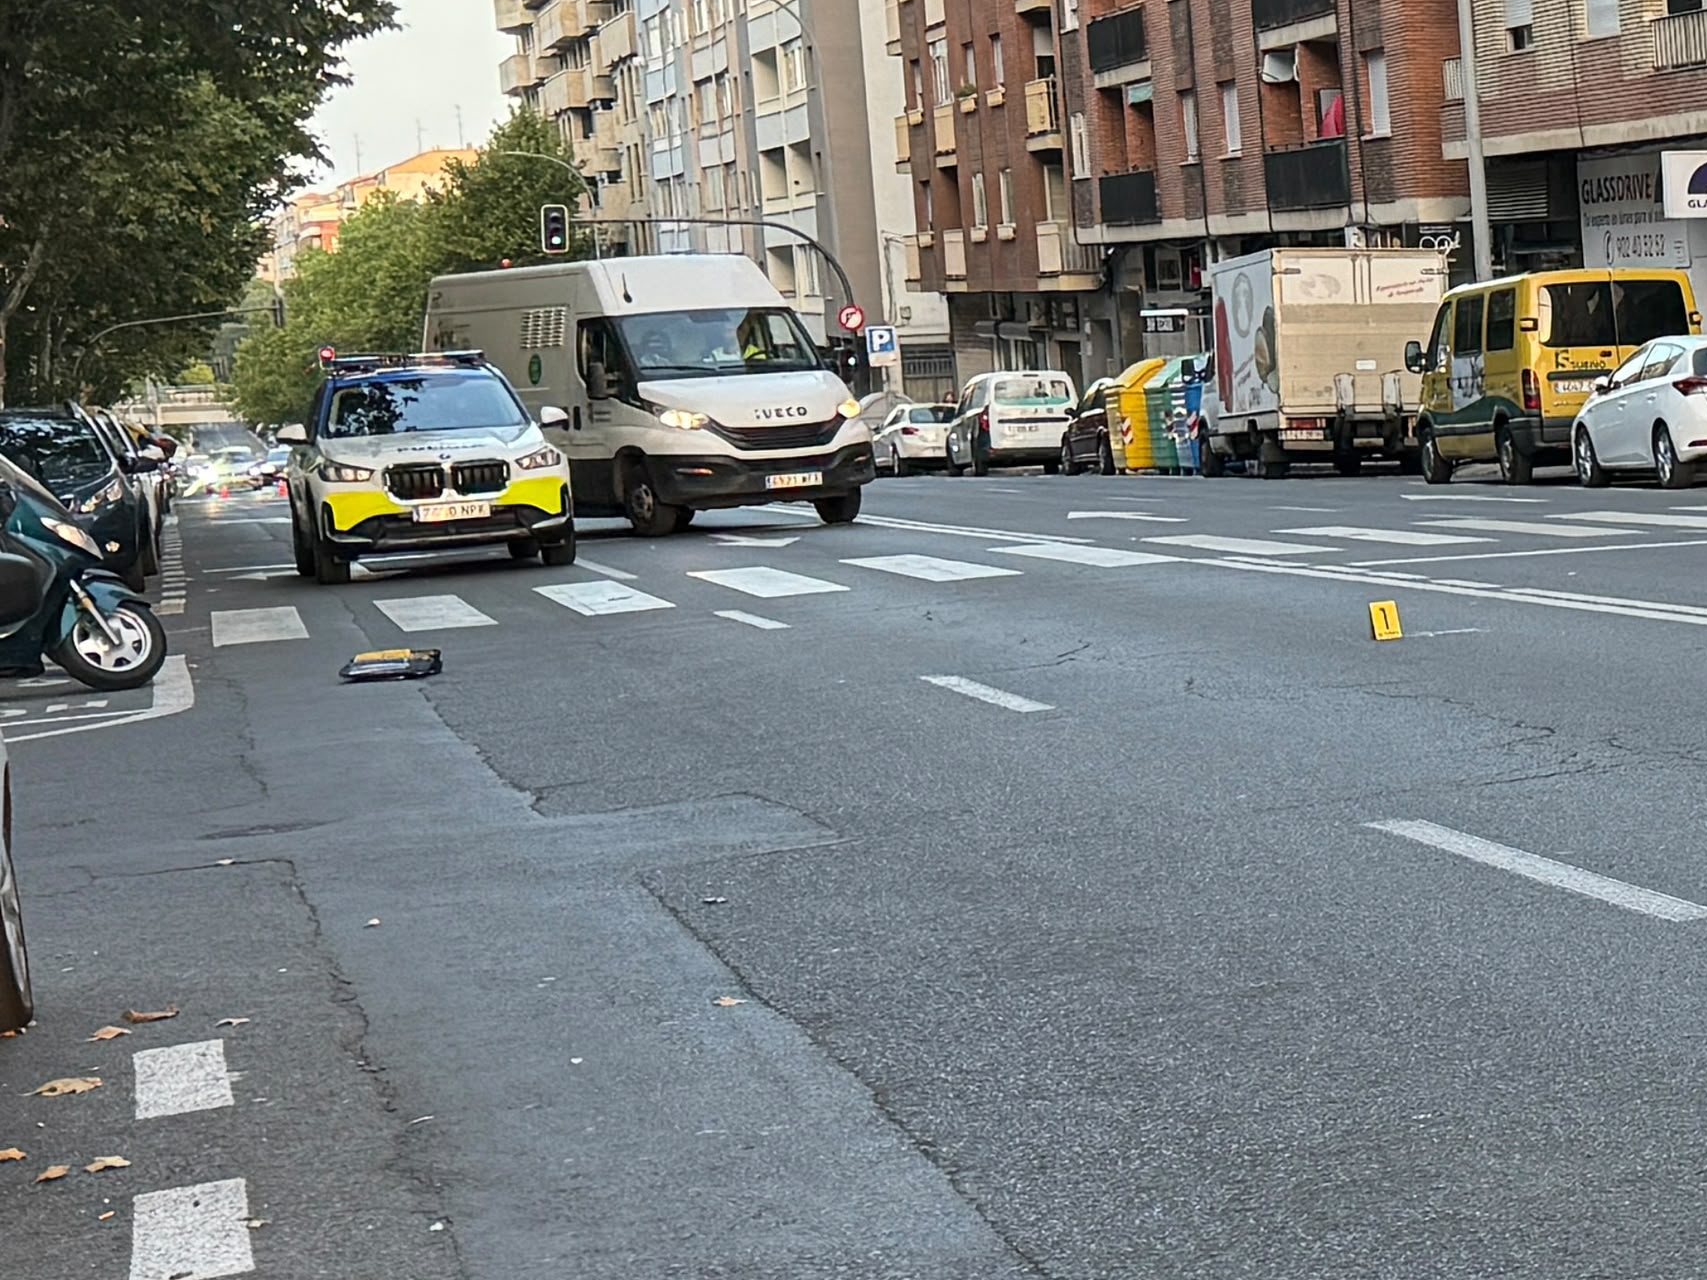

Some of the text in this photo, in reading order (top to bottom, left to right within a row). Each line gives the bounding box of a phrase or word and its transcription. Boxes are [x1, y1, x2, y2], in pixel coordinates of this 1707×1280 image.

[1582, 173, 1652, 204] GLASSDRIVE
[872, 330, 891, 351] P
[754, 406, 808, 419] IVECO
[1379, 607, 1389, 630] 1
